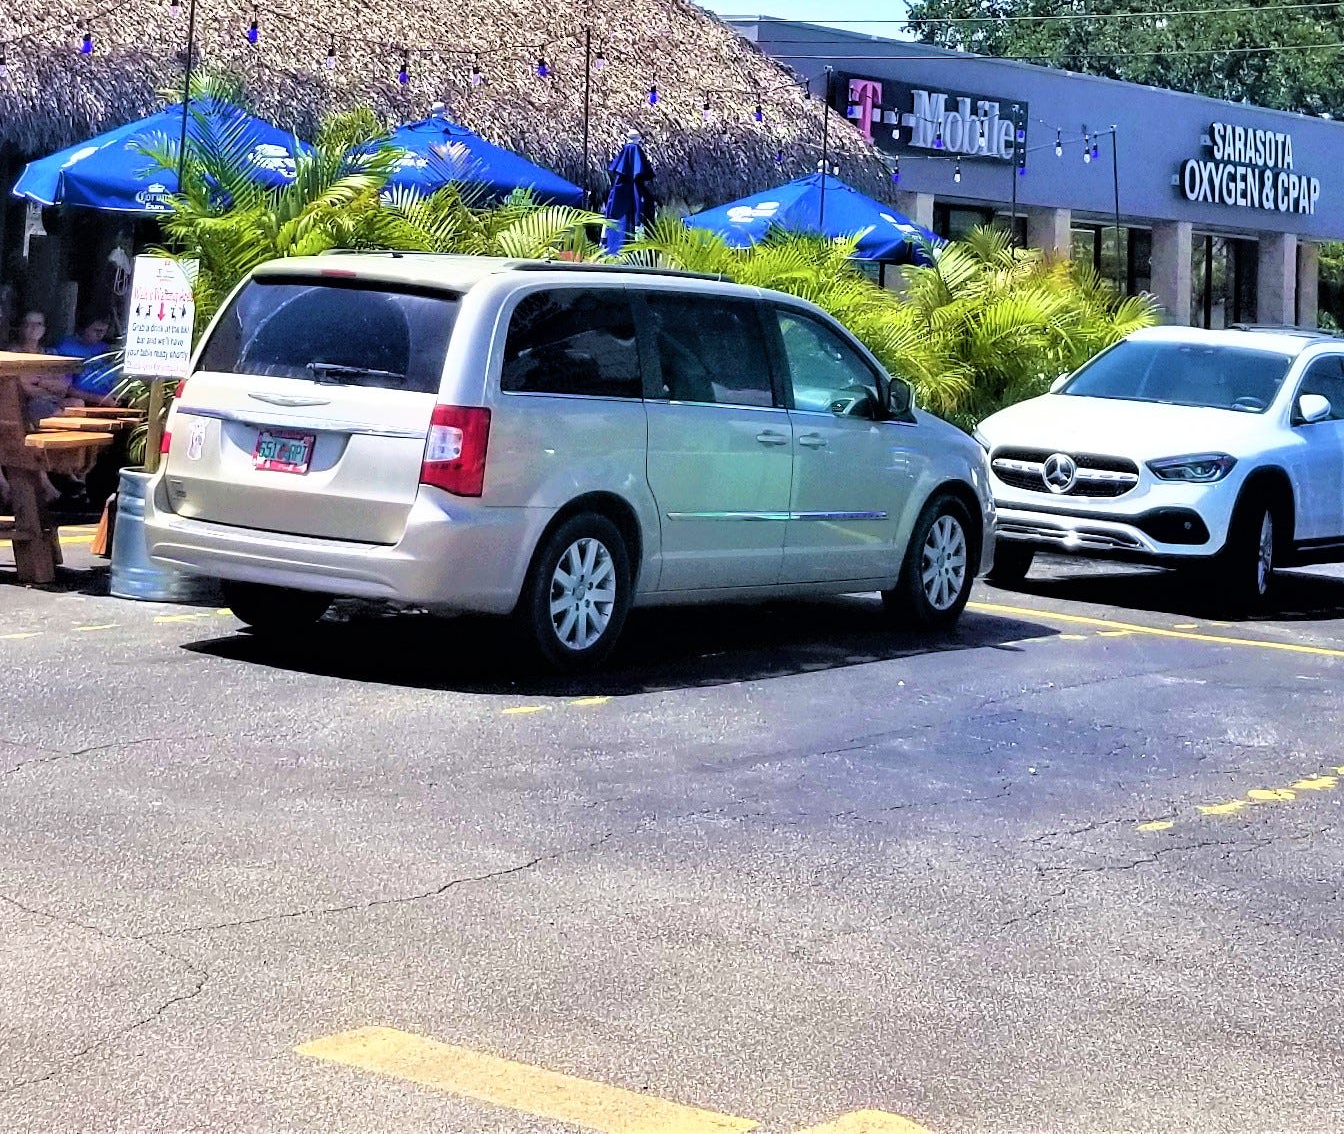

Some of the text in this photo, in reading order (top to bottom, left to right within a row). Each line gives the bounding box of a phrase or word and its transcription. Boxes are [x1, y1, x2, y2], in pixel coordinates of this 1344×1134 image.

[1213, 122, 1294, 170] SARASOTA
[1184, 159, 1320, 215] OXYGEN & CPAP
